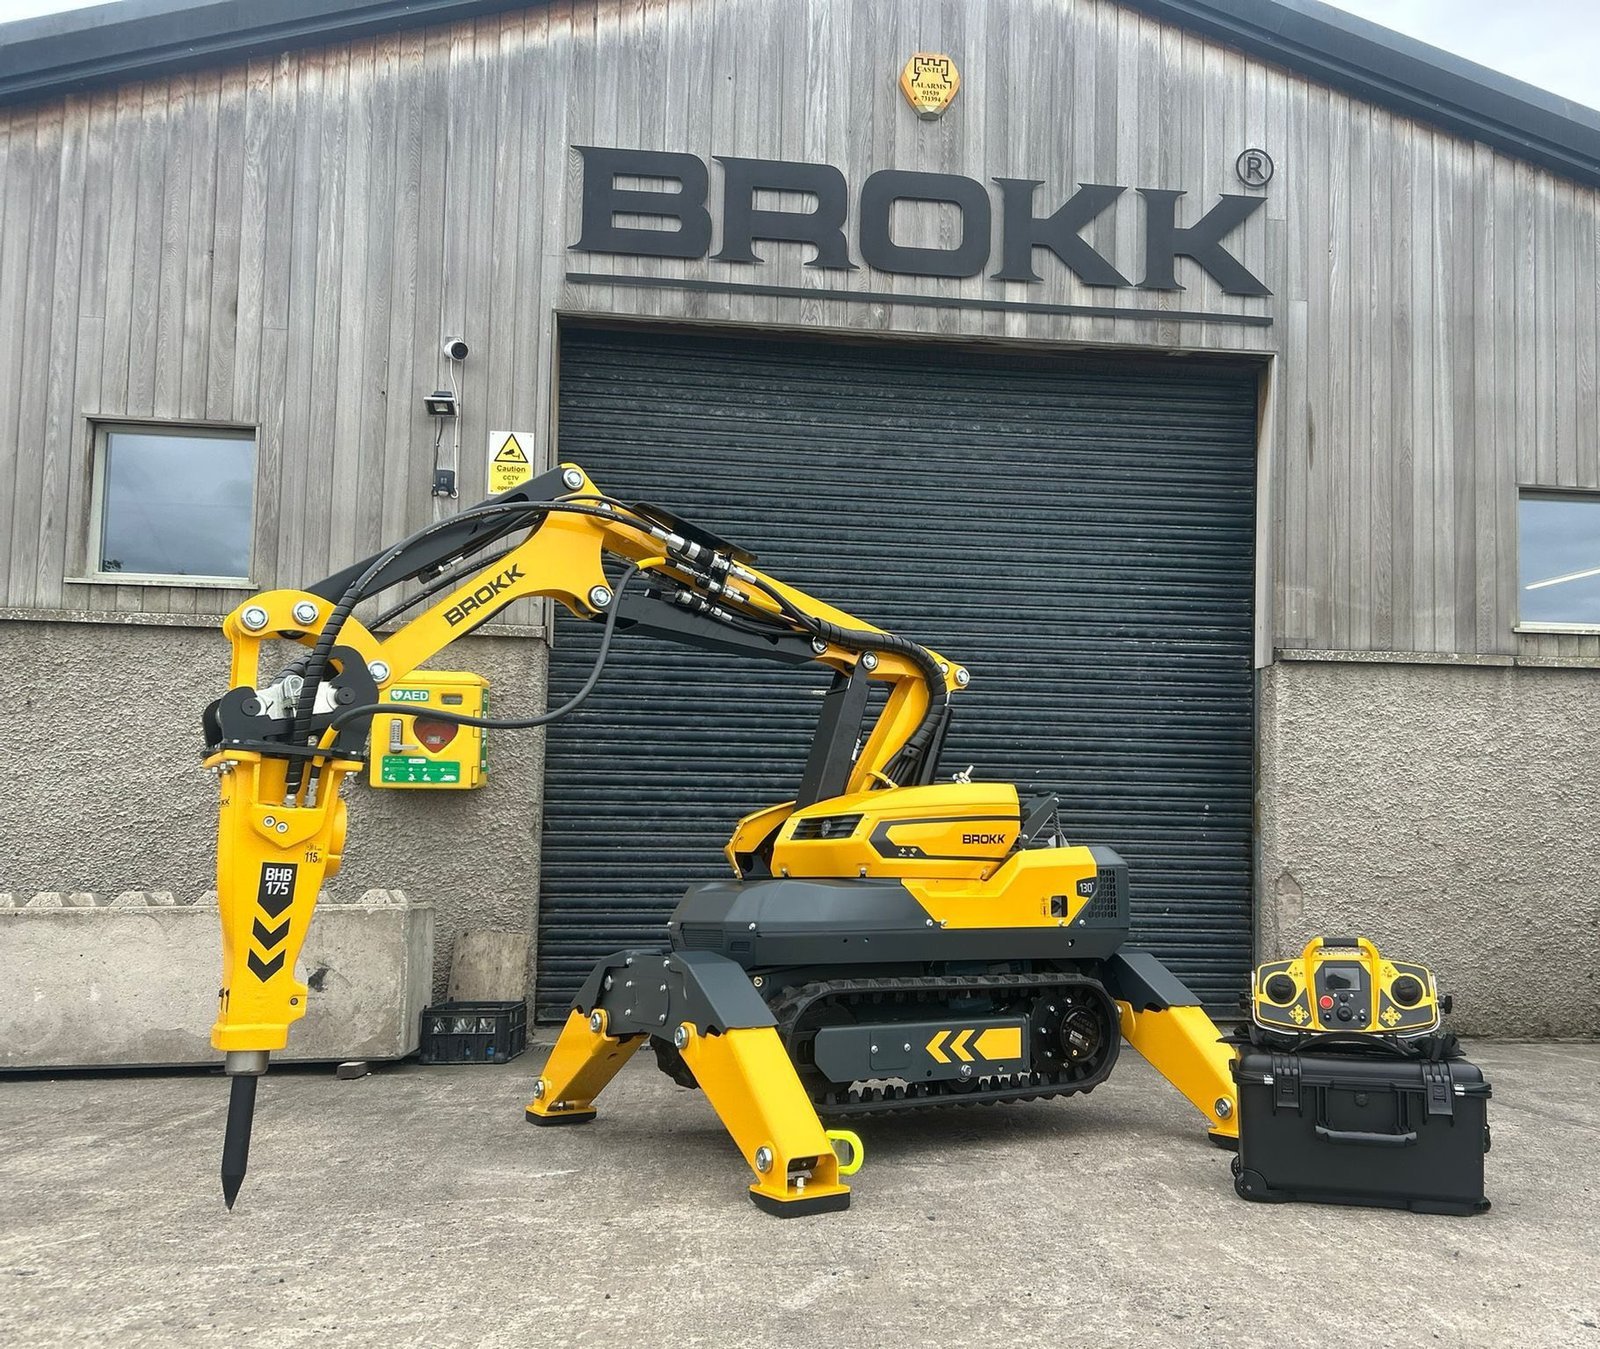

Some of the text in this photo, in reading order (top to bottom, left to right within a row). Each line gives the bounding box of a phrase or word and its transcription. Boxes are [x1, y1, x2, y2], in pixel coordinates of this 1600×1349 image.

[916, 82, 947, 90] ALARMS
[567, 144, 1273, 296] BROKK
[496, 464, 526, 473] Caution
[442, 563, 526, 627] BROKK
[403, 691, 429, 700] AED
[962, 833, 1005, 845] BROKK
[305, 851, 318, 863] 115
[265, 867, 293, 881] BHB
[265, 881, 290, 895] 175
